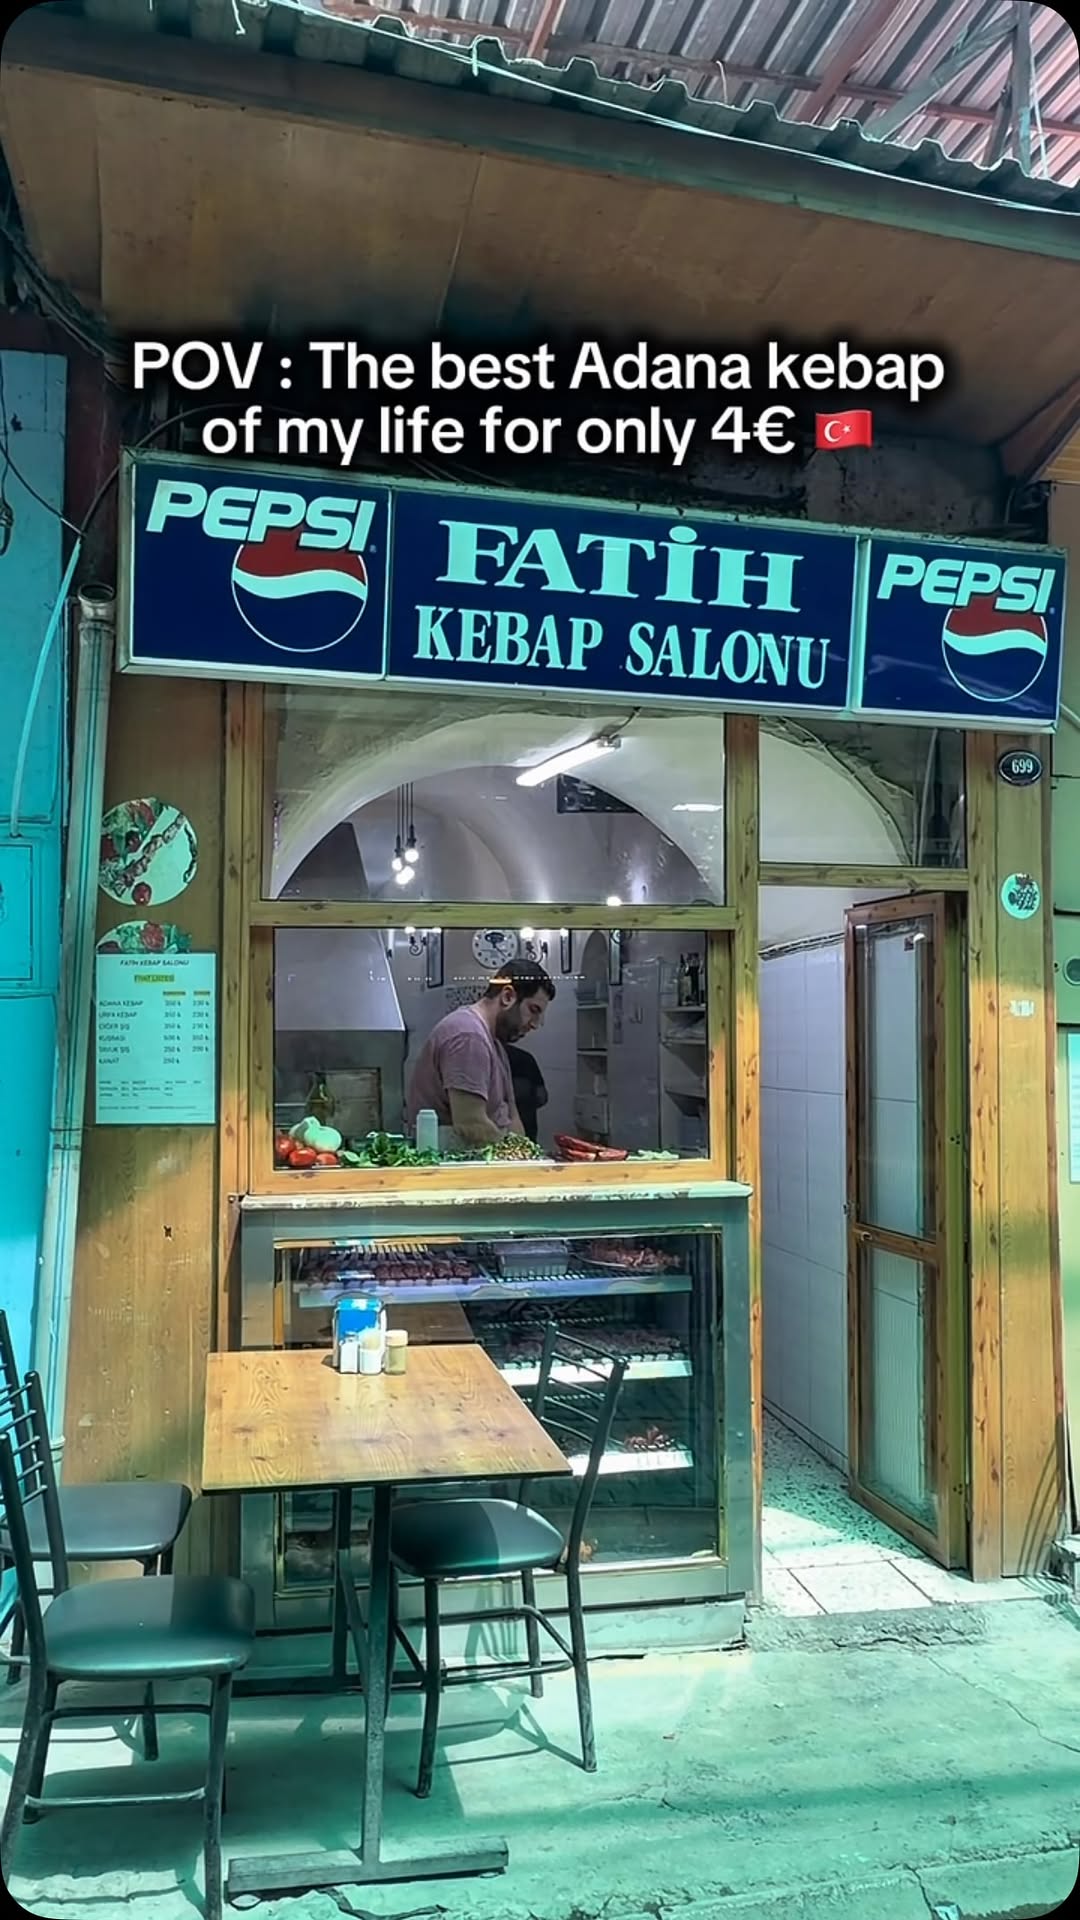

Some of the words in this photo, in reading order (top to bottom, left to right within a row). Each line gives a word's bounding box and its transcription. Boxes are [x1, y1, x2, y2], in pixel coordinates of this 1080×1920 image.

[146, 479, 376, 552] PEPSI
[436, 520, 804, 613] FATİH
[877, 553, 1056, 613] PEPSI
[413, 605, 603, 670] KEBAP
[625, 621, 830, 689] SALONU
[1011, 757, 1033, 774] 699
